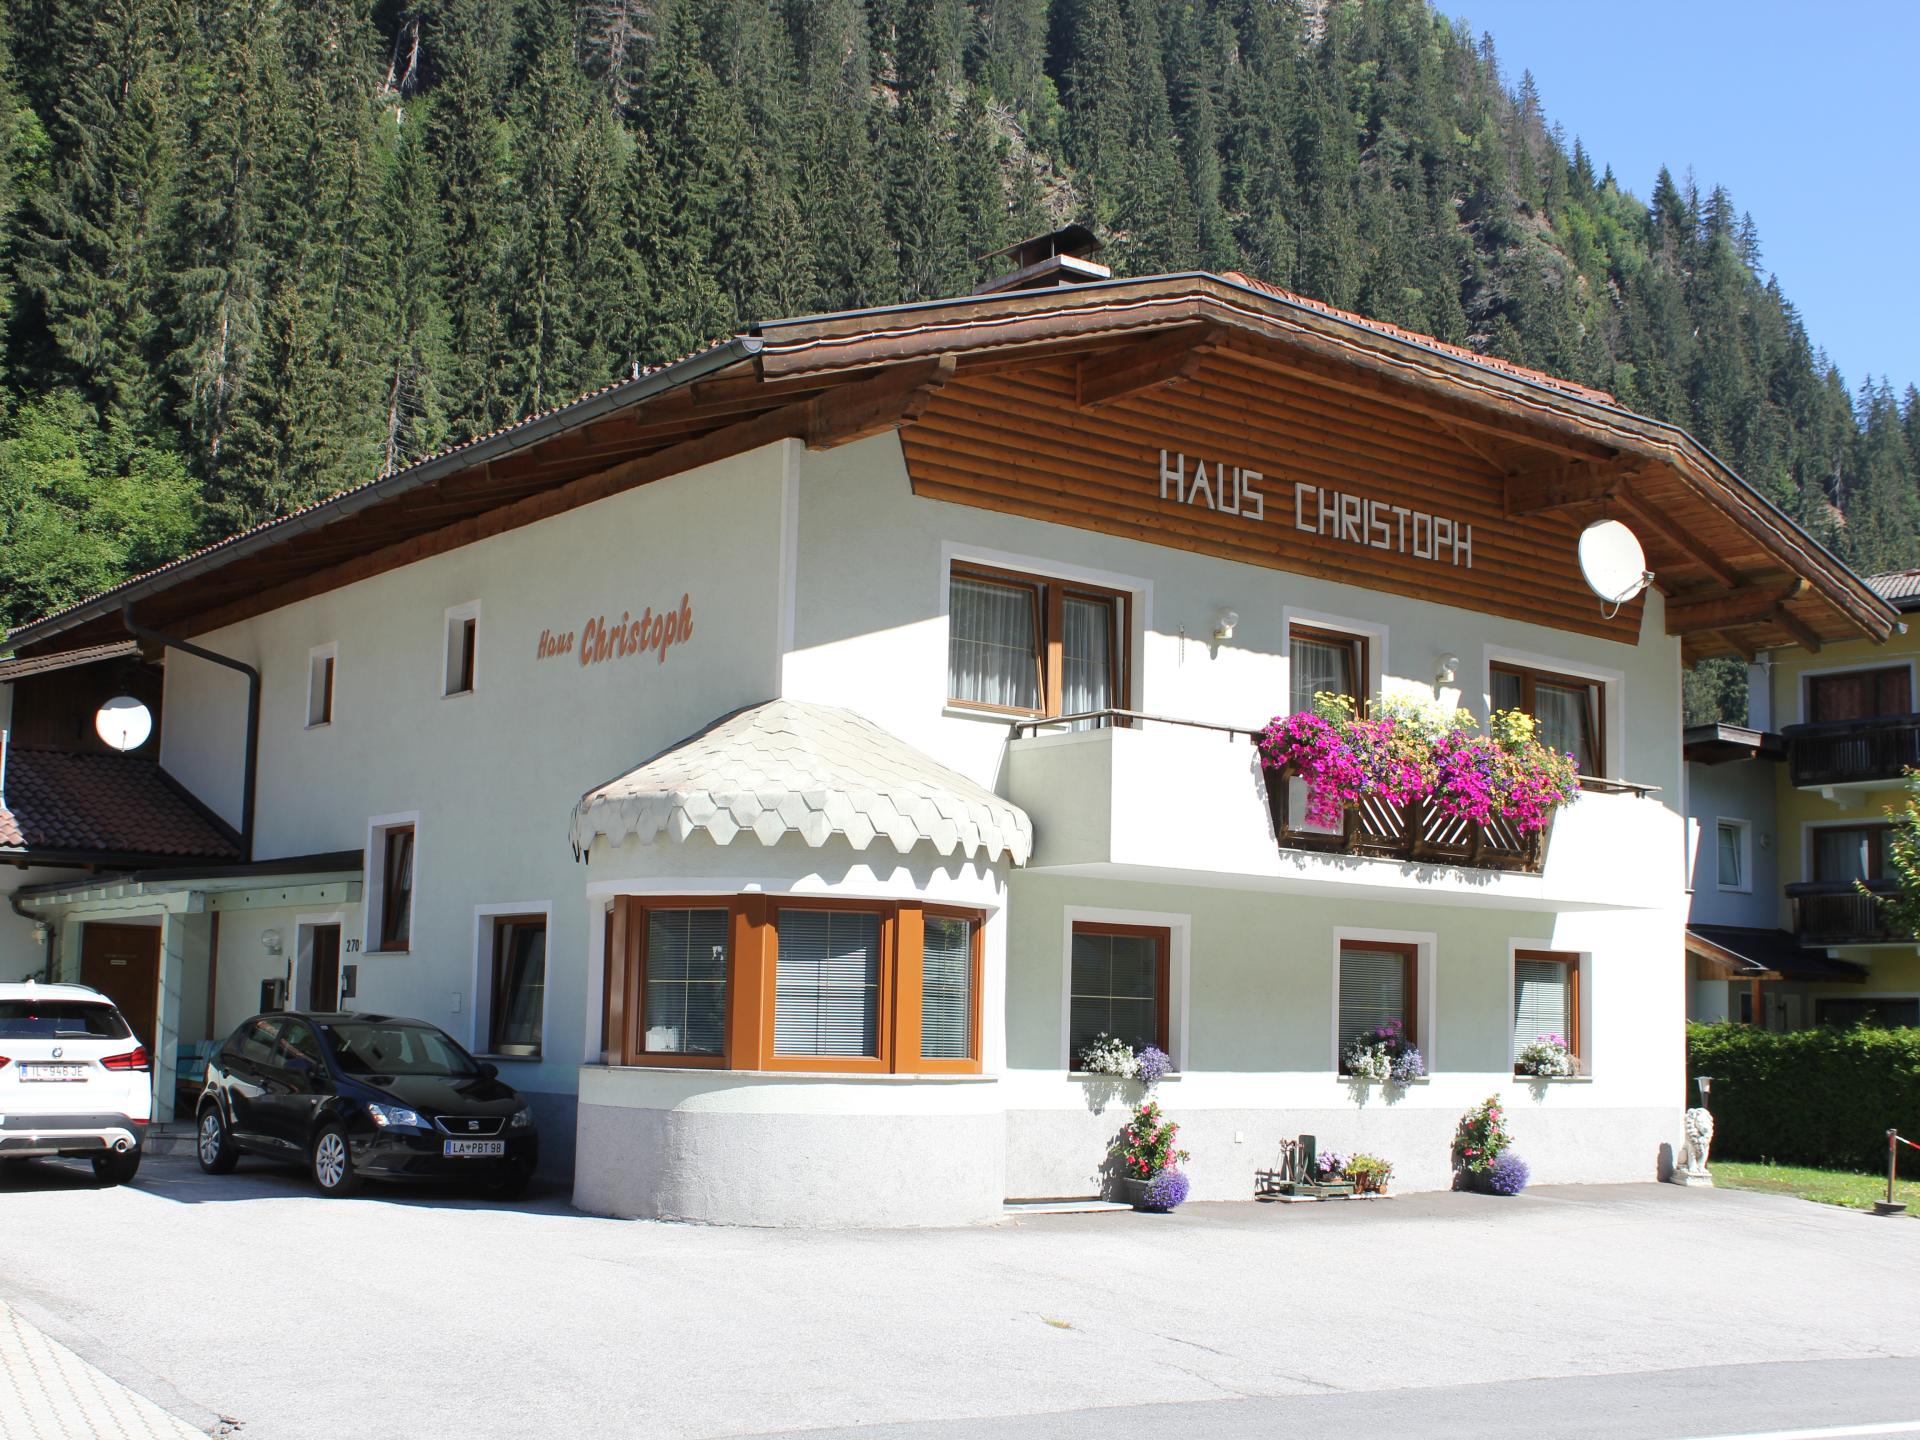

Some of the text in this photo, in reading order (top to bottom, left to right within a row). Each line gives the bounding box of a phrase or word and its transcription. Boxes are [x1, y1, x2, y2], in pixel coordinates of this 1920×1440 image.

[1159, 449, 1472, 568] HAUS CHRISTOPH
[537, 592, 693, 666] Haus Christoph
[346, 939, 360, 952] 270
